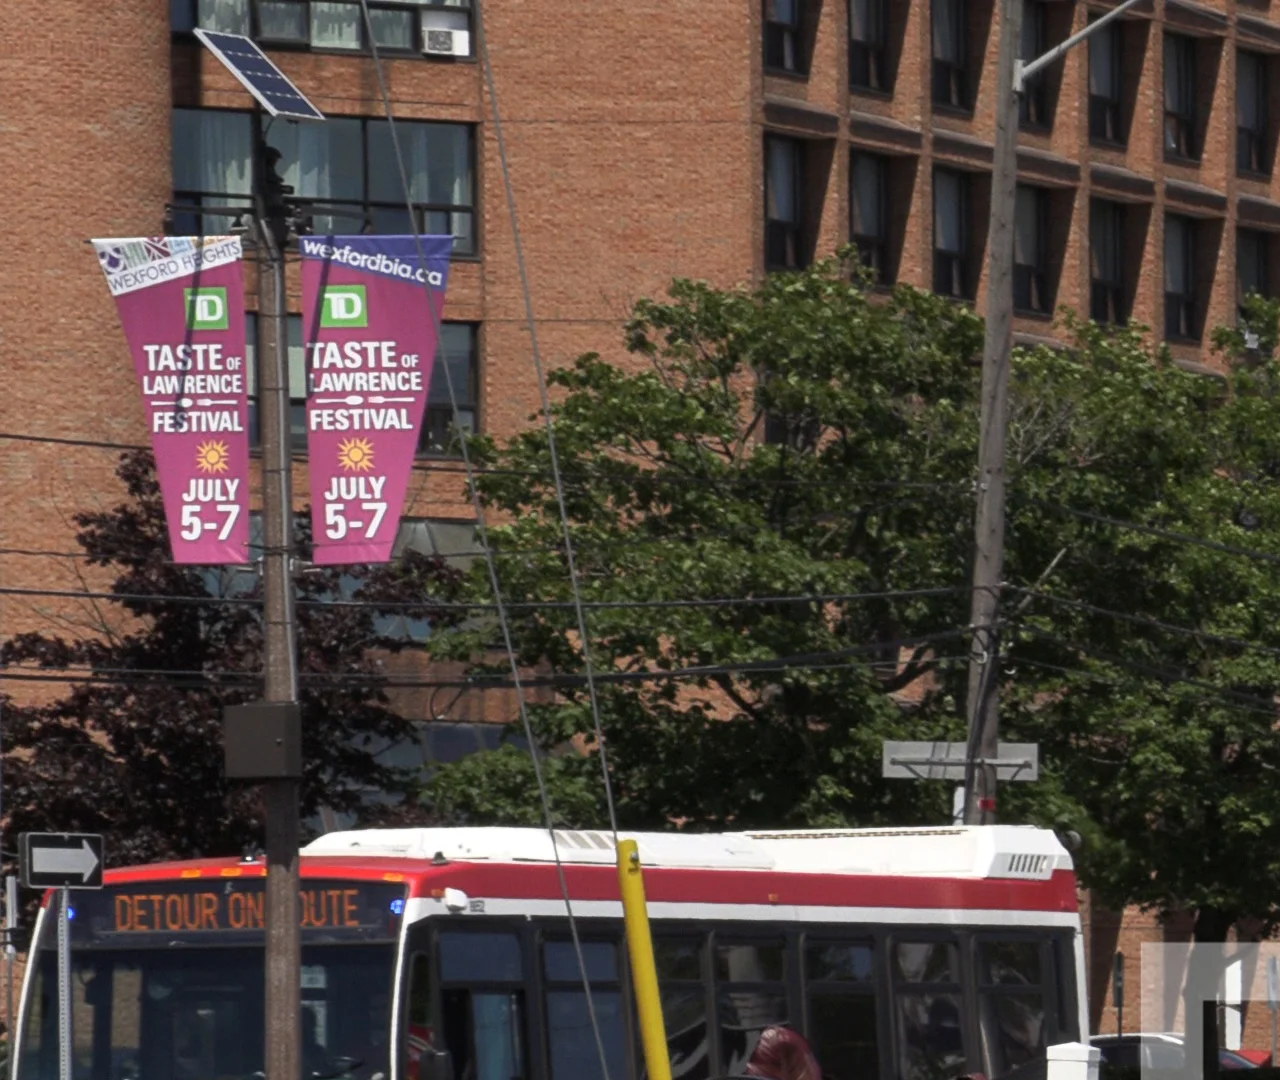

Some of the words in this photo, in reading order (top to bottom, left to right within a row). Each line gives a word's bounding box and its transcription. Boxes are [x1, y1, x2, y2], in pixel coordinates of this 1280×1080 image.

[109, 260, 179, 291] WEXFORD
[183, 240, 240, 268] HEIGHTS
[304, 240, 443, 286] wexfordbia.ca
[188, 295, 224, 321] TD
[324, 293, 362, 319] TD
[143, 344, 224, 372] TASTE
[226, 357, 241, 370] OF
[306, 341, 397, 369] TASTE
[401, 354, 419, 368] OF
[143, 374, 242, 395] LAWRENCE
[309, 371, 423, 393] LAWRENCE
[153, 411, 244, 433] FESTIVAL
[310, 408, 413, 431] FESTIVAL
[182, 478, 240, 502] JULY
[324, 476, 386, 501] JULY
[181, 504, 241, 541] 5-7
[325, 502, 388, 540] 5-7
[115, 893, 220, 932] DETOUR
[229, 891, 266, 930] ON
